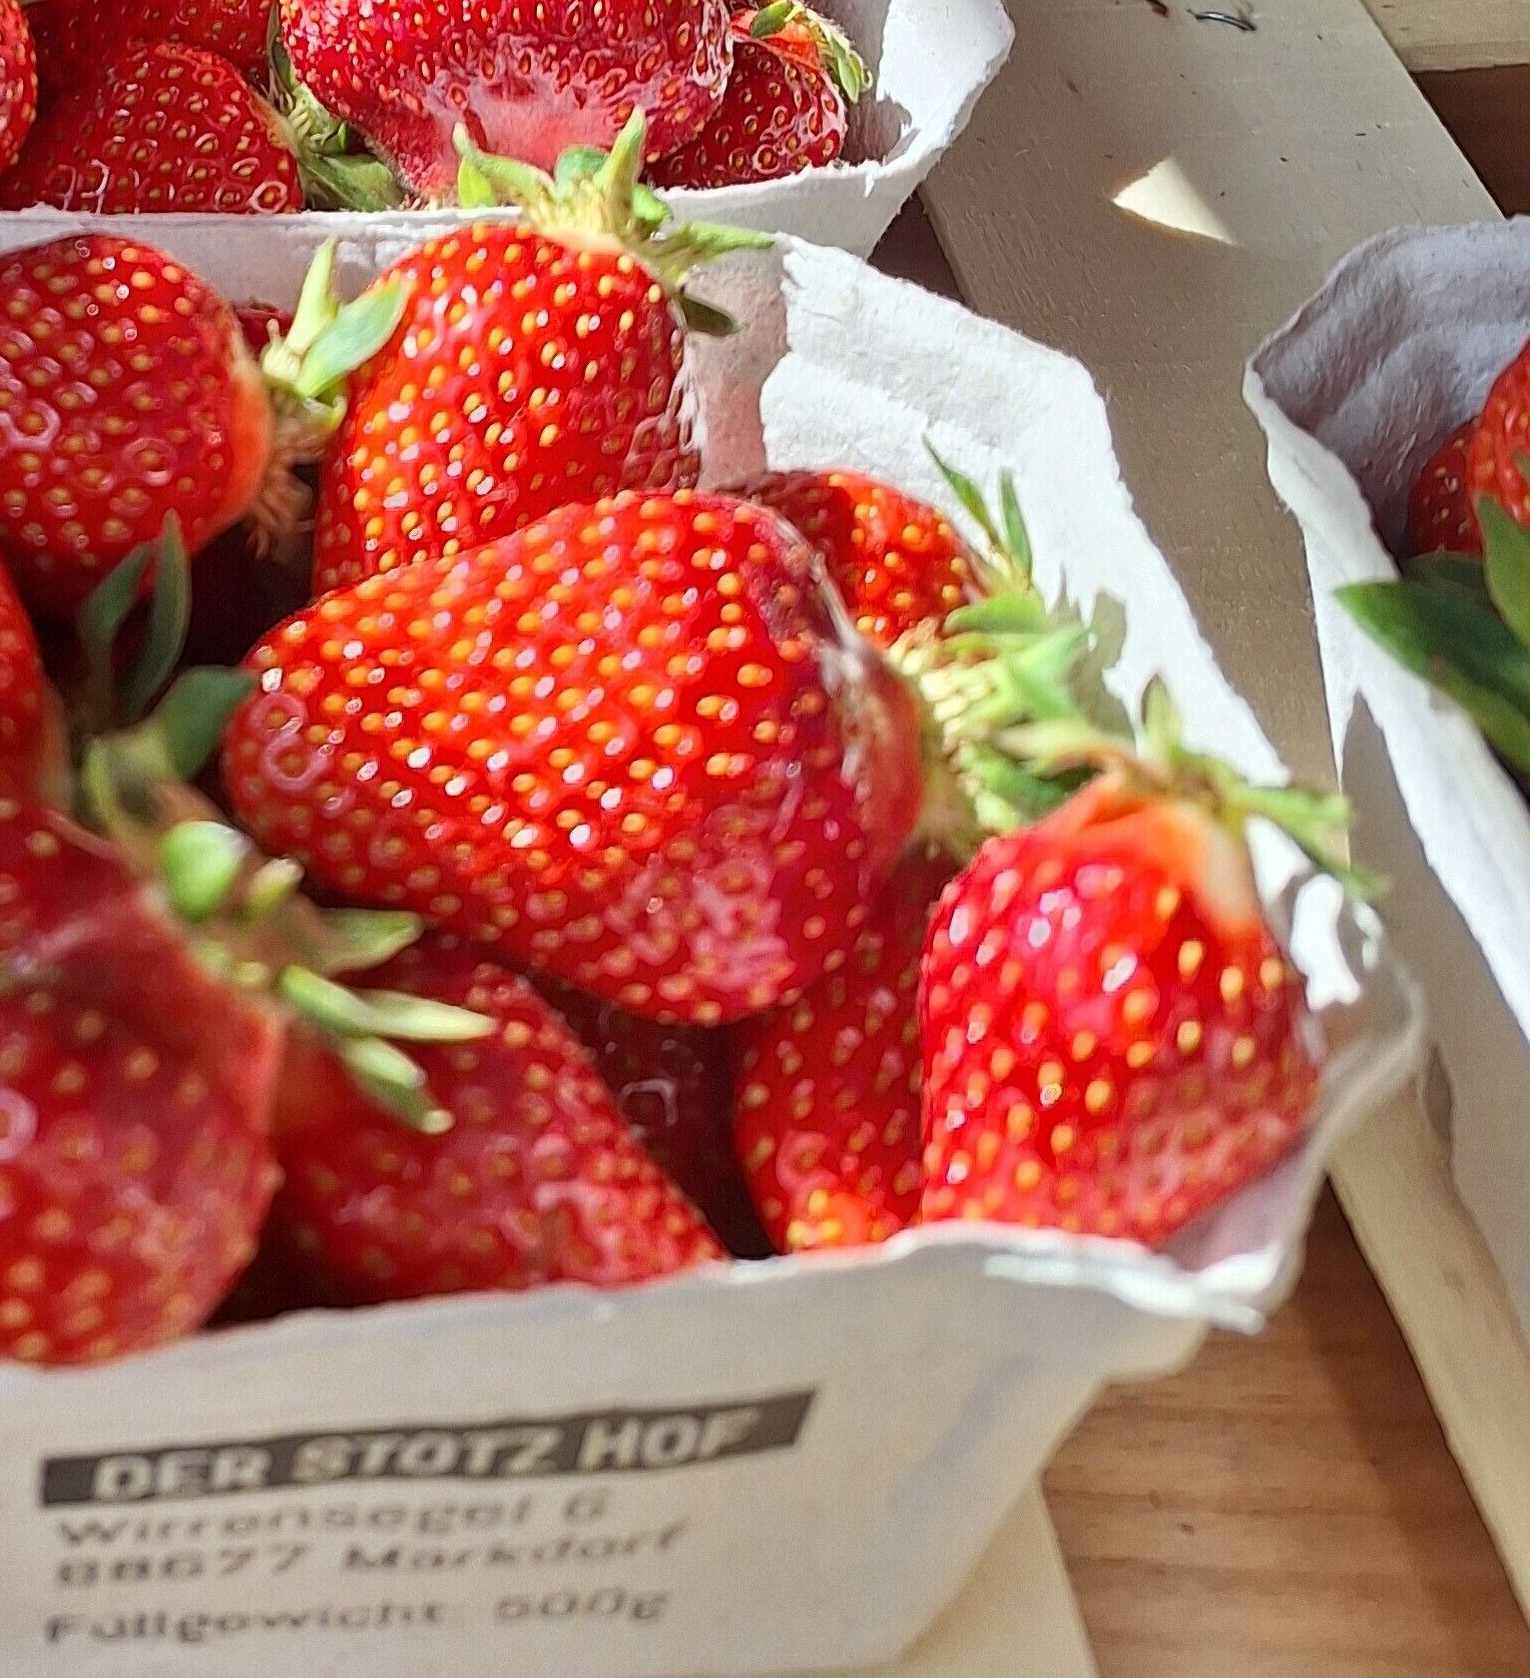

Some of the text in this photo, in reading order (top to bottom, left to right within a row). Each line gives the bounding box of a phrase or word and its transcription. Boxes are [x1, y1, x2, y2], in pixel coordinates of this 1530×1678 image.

[91, 1407, 764, 1501] DER STOTZ HOF
[340, 1520, 692, 1572] Markdorf
